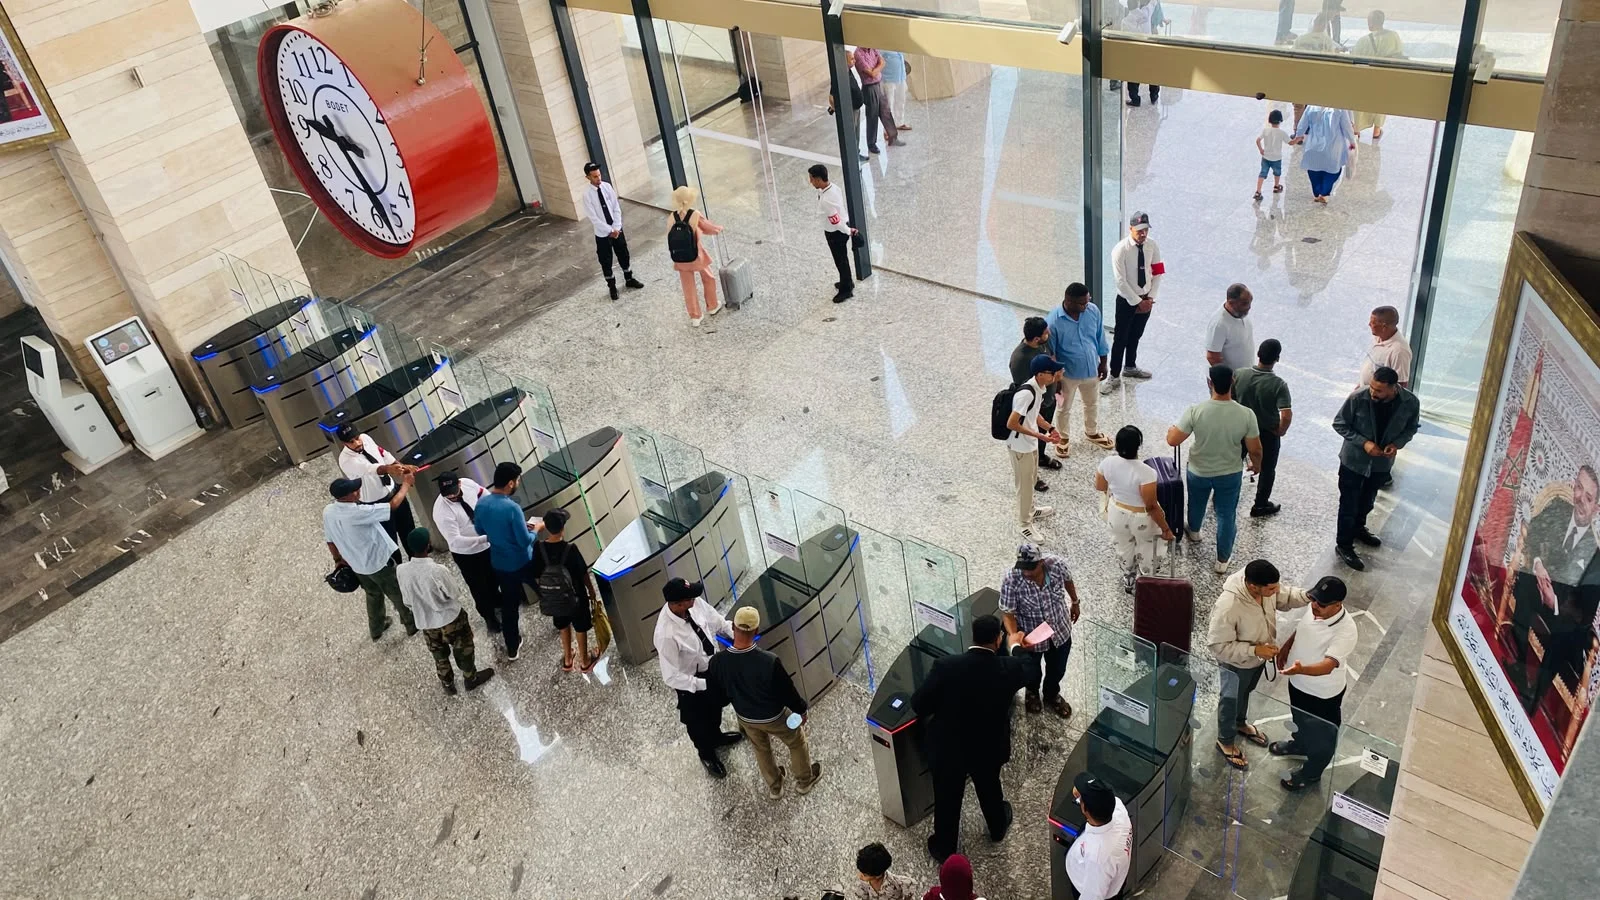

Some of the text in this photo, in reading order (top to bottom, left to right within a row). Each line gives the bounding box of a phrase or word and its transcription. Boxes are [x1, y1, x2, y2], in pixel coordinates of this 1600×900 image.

[291, 50, 315, 80] 11
[308, 46, 333, 75] 12
[339, 62, 355, 88] 1
[286, 77, 308, 106] 10
[325, 99, 349, 113] BODET
[297, 113, 311, 139] 9
[318, 154, 333, 179] 8
[390, 142, 405, 169] 3
[344, 188, 357, 213] 7
[397, 181, 410, 208] 4
[371, 205, 384, 229] 6
[389, 203, 403, 228] 5
